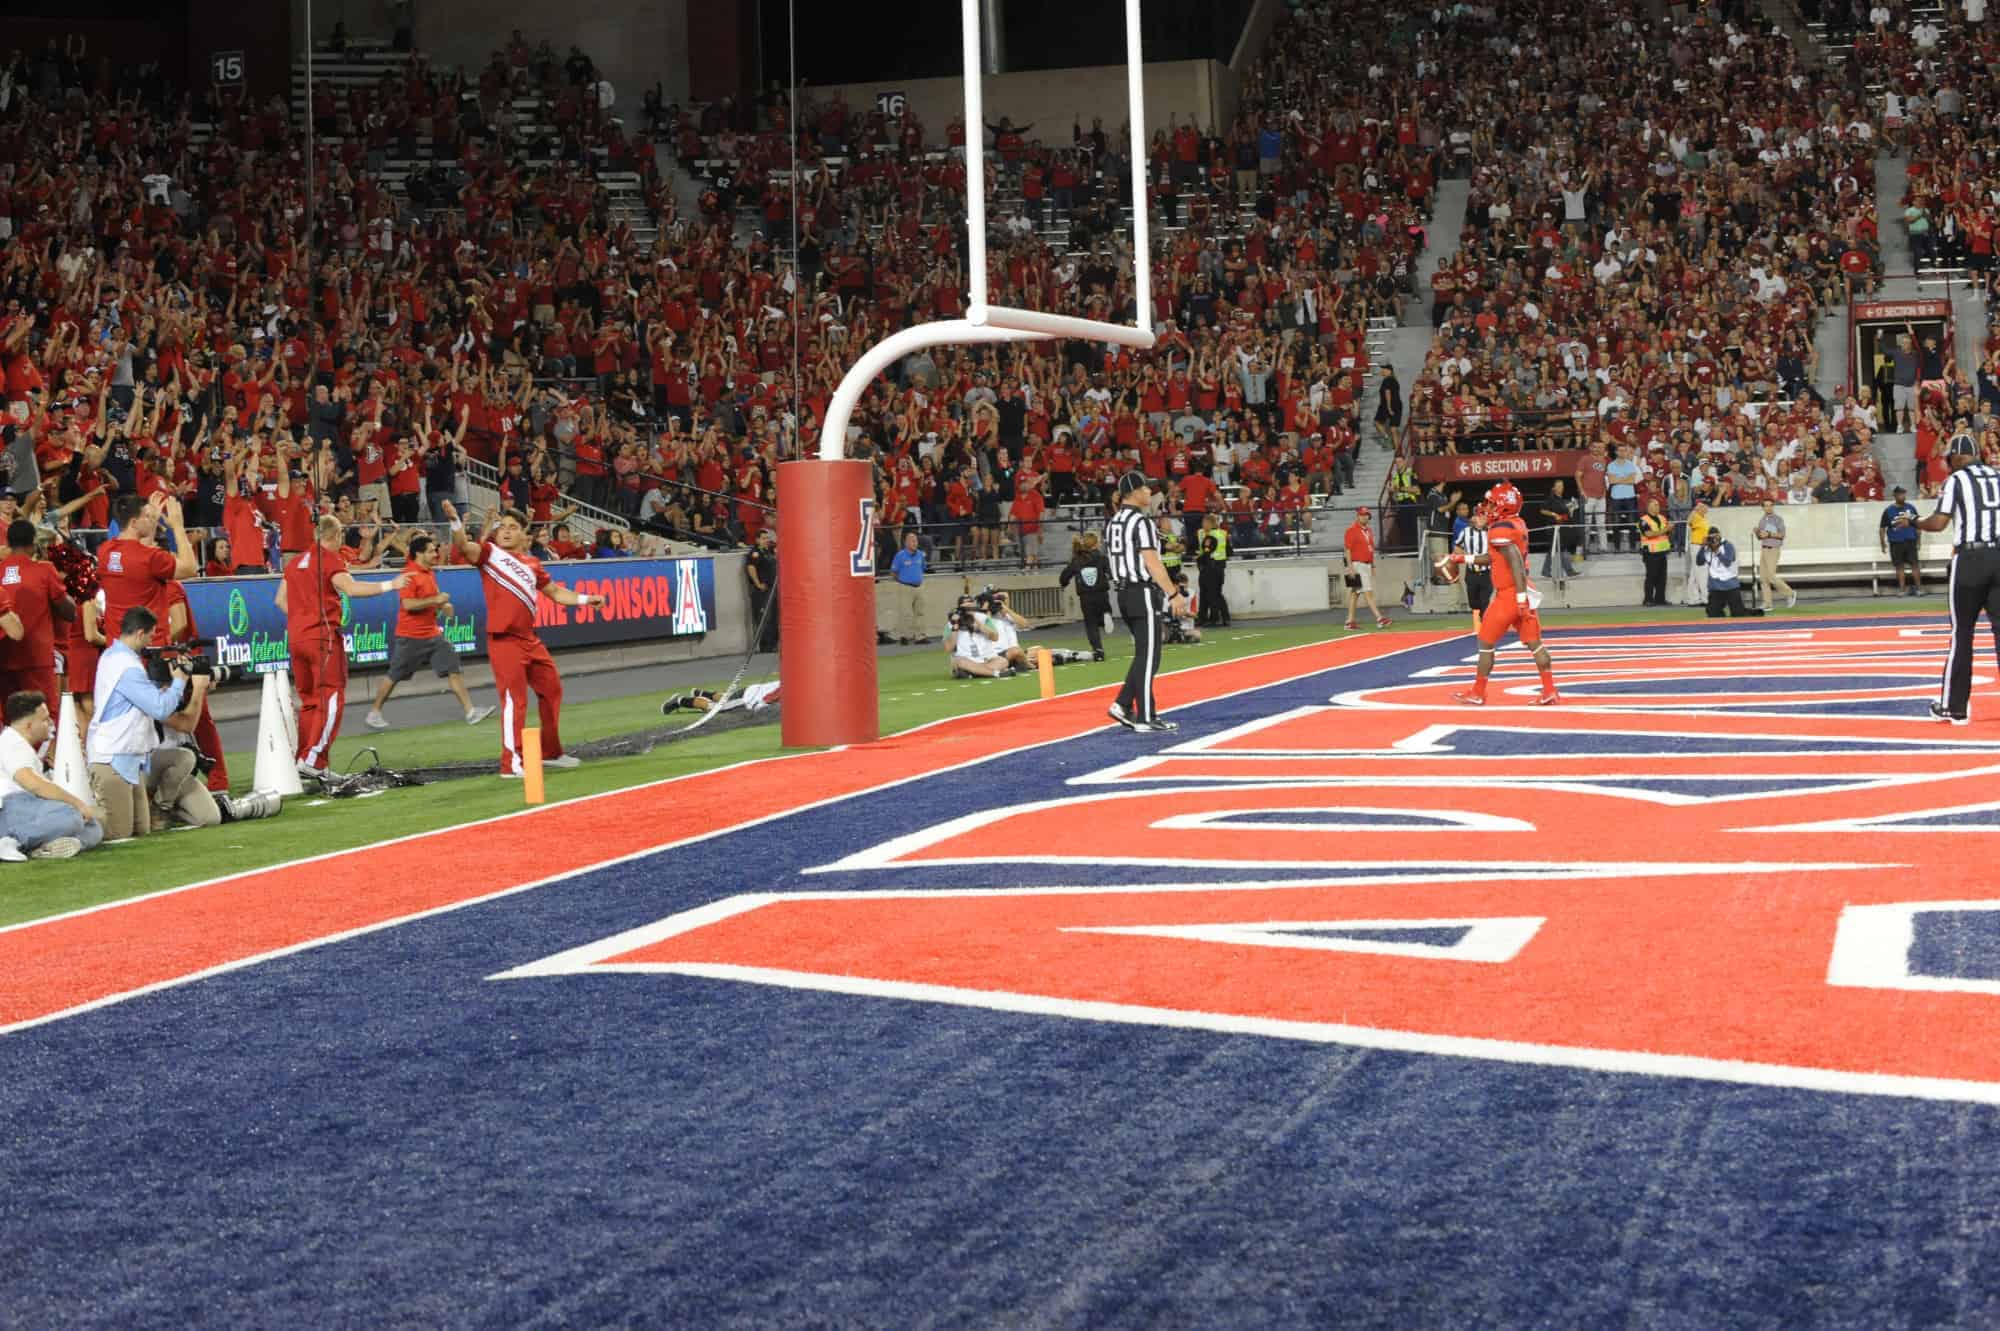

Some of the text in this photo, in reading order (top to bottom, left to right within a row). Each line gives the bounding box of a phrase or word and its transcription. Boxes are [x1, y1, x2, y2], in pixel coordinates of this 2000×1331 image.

[215, 57, 241, 80] 15
[878, 95, 905, 117] 16
[1471, 458, 1542, 474] 16 SECTION 17
[1976, 477, 2000, 507] U
[575, 575, 671, 624] SPONSOR
[672, 559, 707, 635] A
